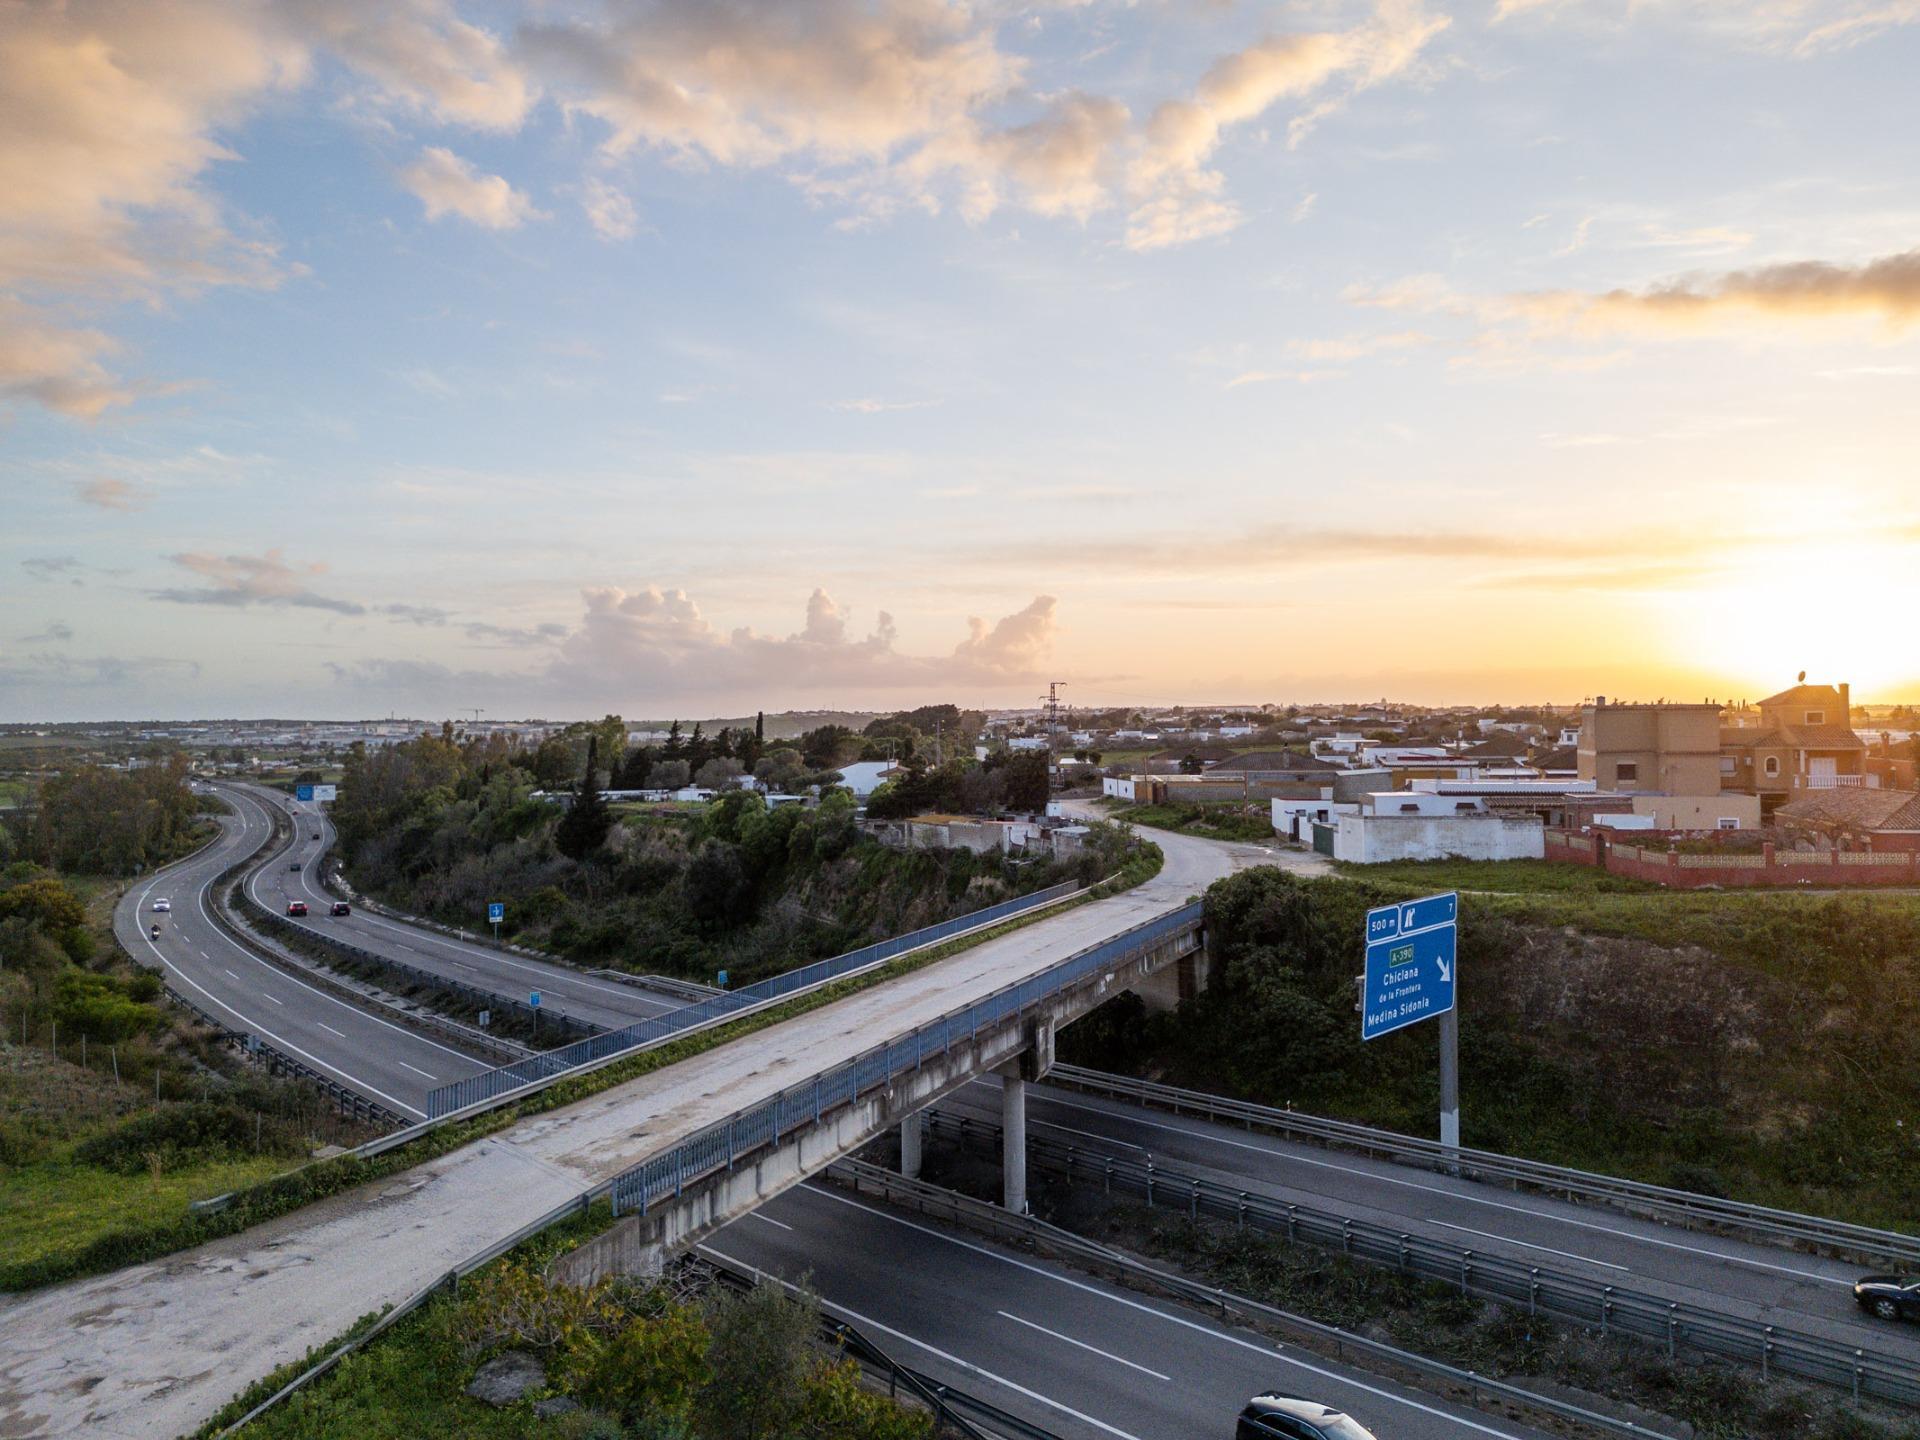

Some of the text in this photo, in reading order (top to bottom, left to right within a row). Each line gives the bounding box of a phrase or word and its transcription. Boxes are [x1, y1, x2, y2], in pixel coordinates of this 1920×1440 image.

[1449, 903, 1453, 912] 7
[1372, 919, 1395, 932] 500 m
[1392, 949, 1412, 962] A-390
[1384, 968, 1419, 986] Chiclana
[1379, 984, 1421, 1003] de la Frontera
[1368, 997, 1429, 1026] Medina Sidonia
